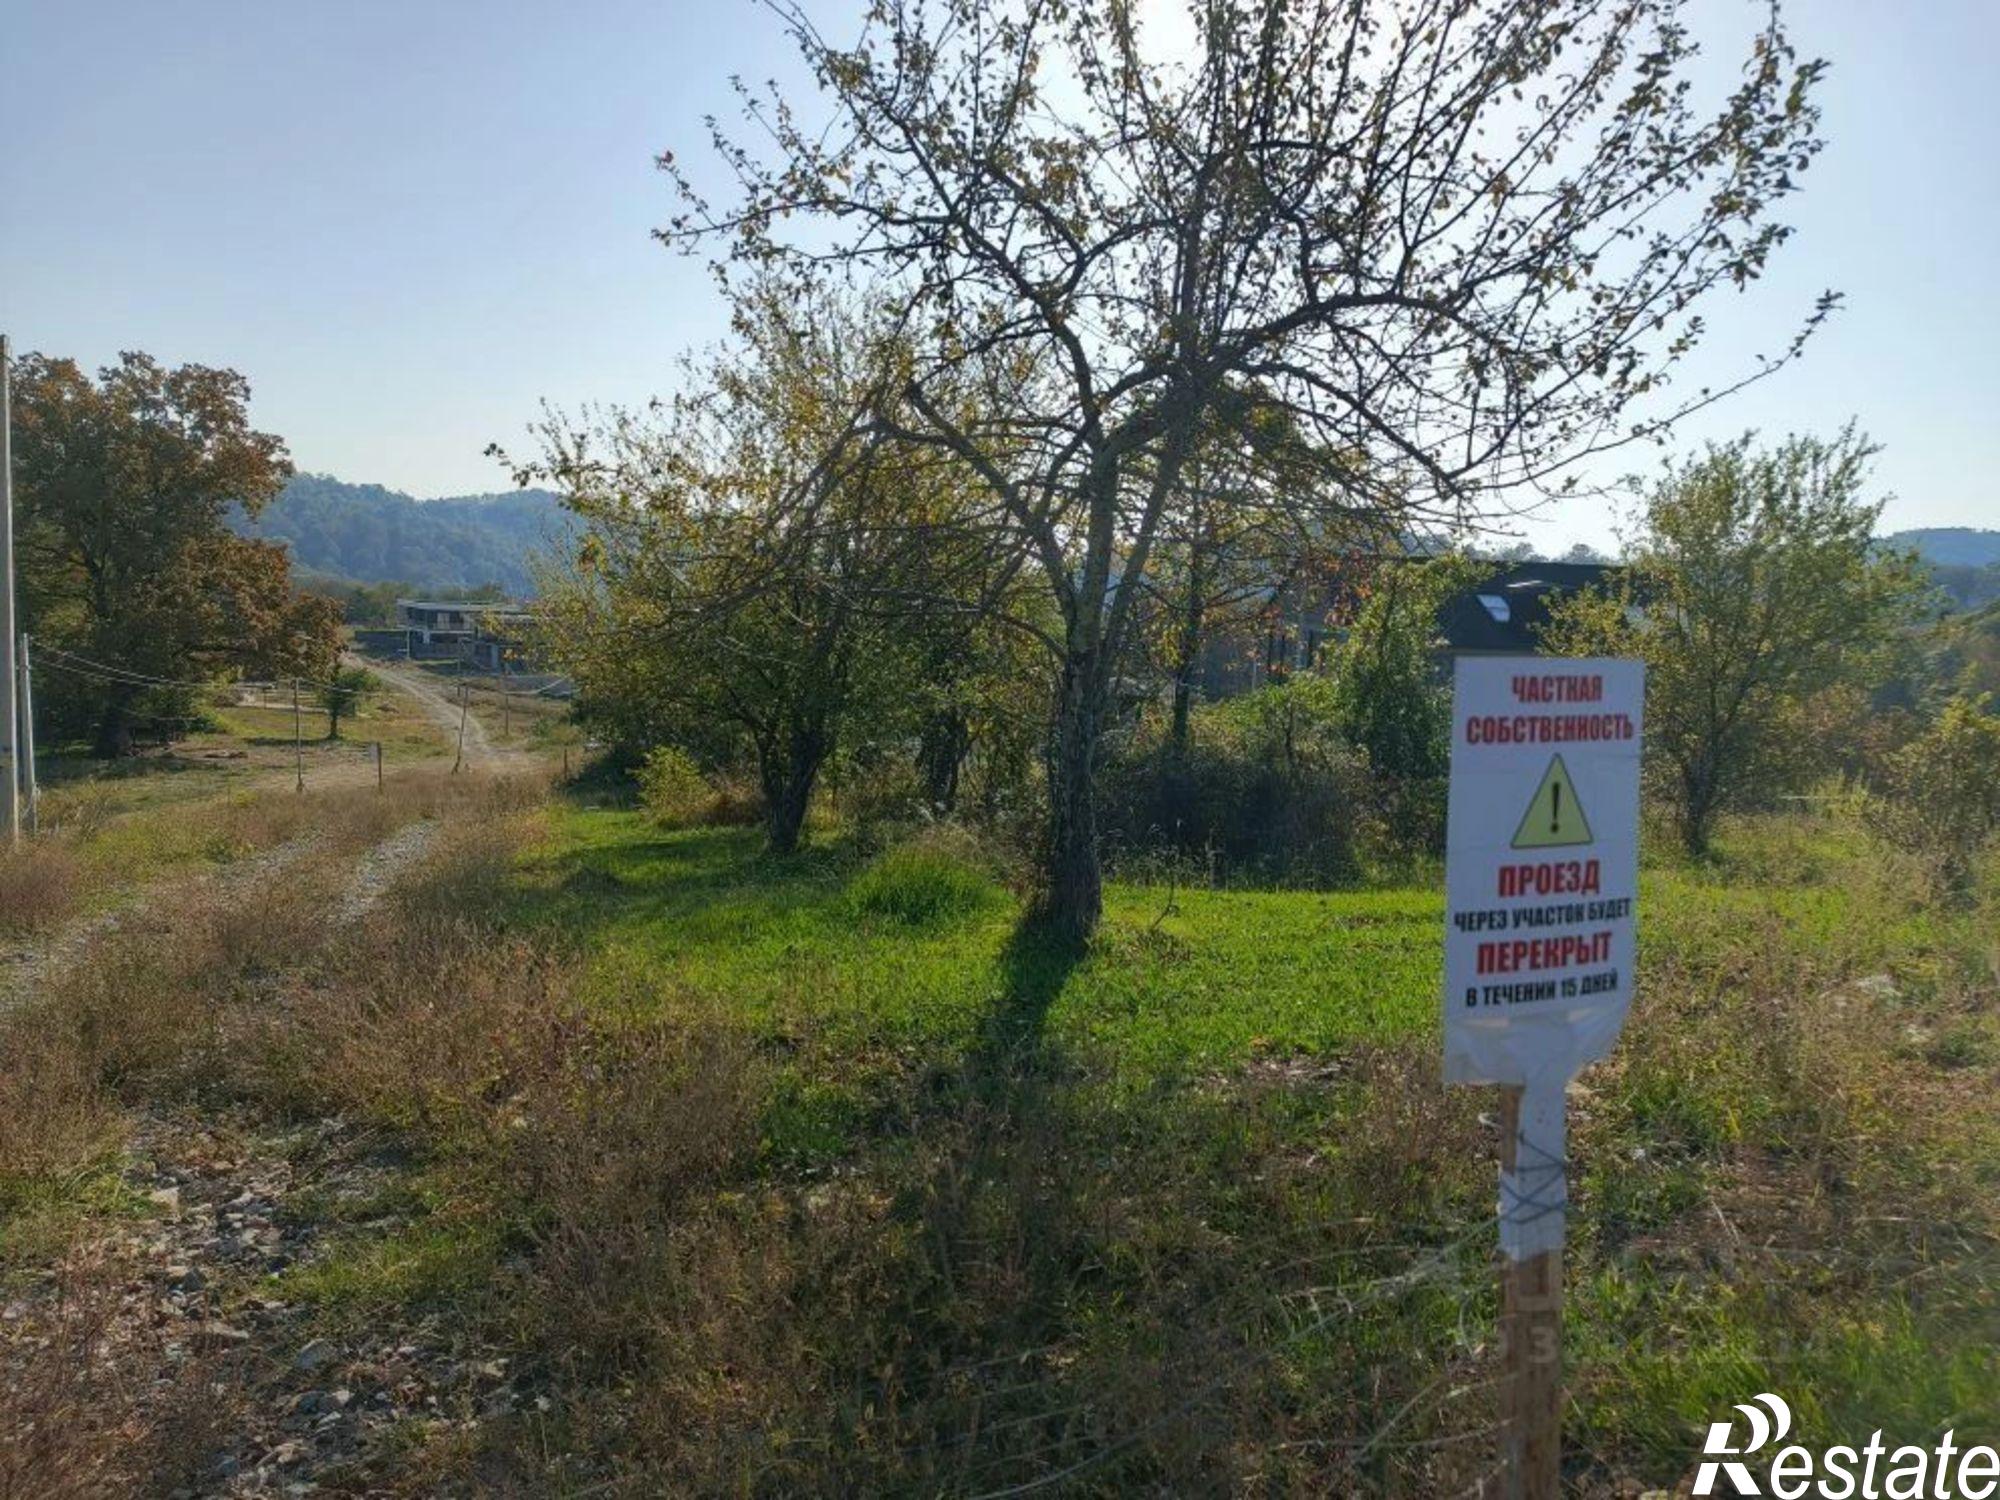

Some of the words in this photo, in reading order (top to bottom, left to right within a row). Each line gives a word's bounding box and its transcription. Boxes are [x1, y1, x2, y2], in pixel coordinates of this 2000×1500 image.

[1511, 675, 1603, 704] ЧАСТНАЯ
[1466, 714, 1634, 745] СОБСТВЕННОСТЬ
[1498, 860, 1600, 897] ПРОЕЗД
[1454, 909, 1508, 933] ЧЕРЕЗ
[1512, 902, 1584, 930] УЧАСТОК
[1588, 898, 1631, 922] БУДЕТ
[1477, 931, 1613, 975] ПЕРЕКРЫТ
[1466, 987, 1477, 1007] В
[1481, 979, 1557, 1007] ТЕЧЕНИИ
[1561, 976, 1577, 998] 15
[1580, 968, 1619, 997] ДНЕЙ
